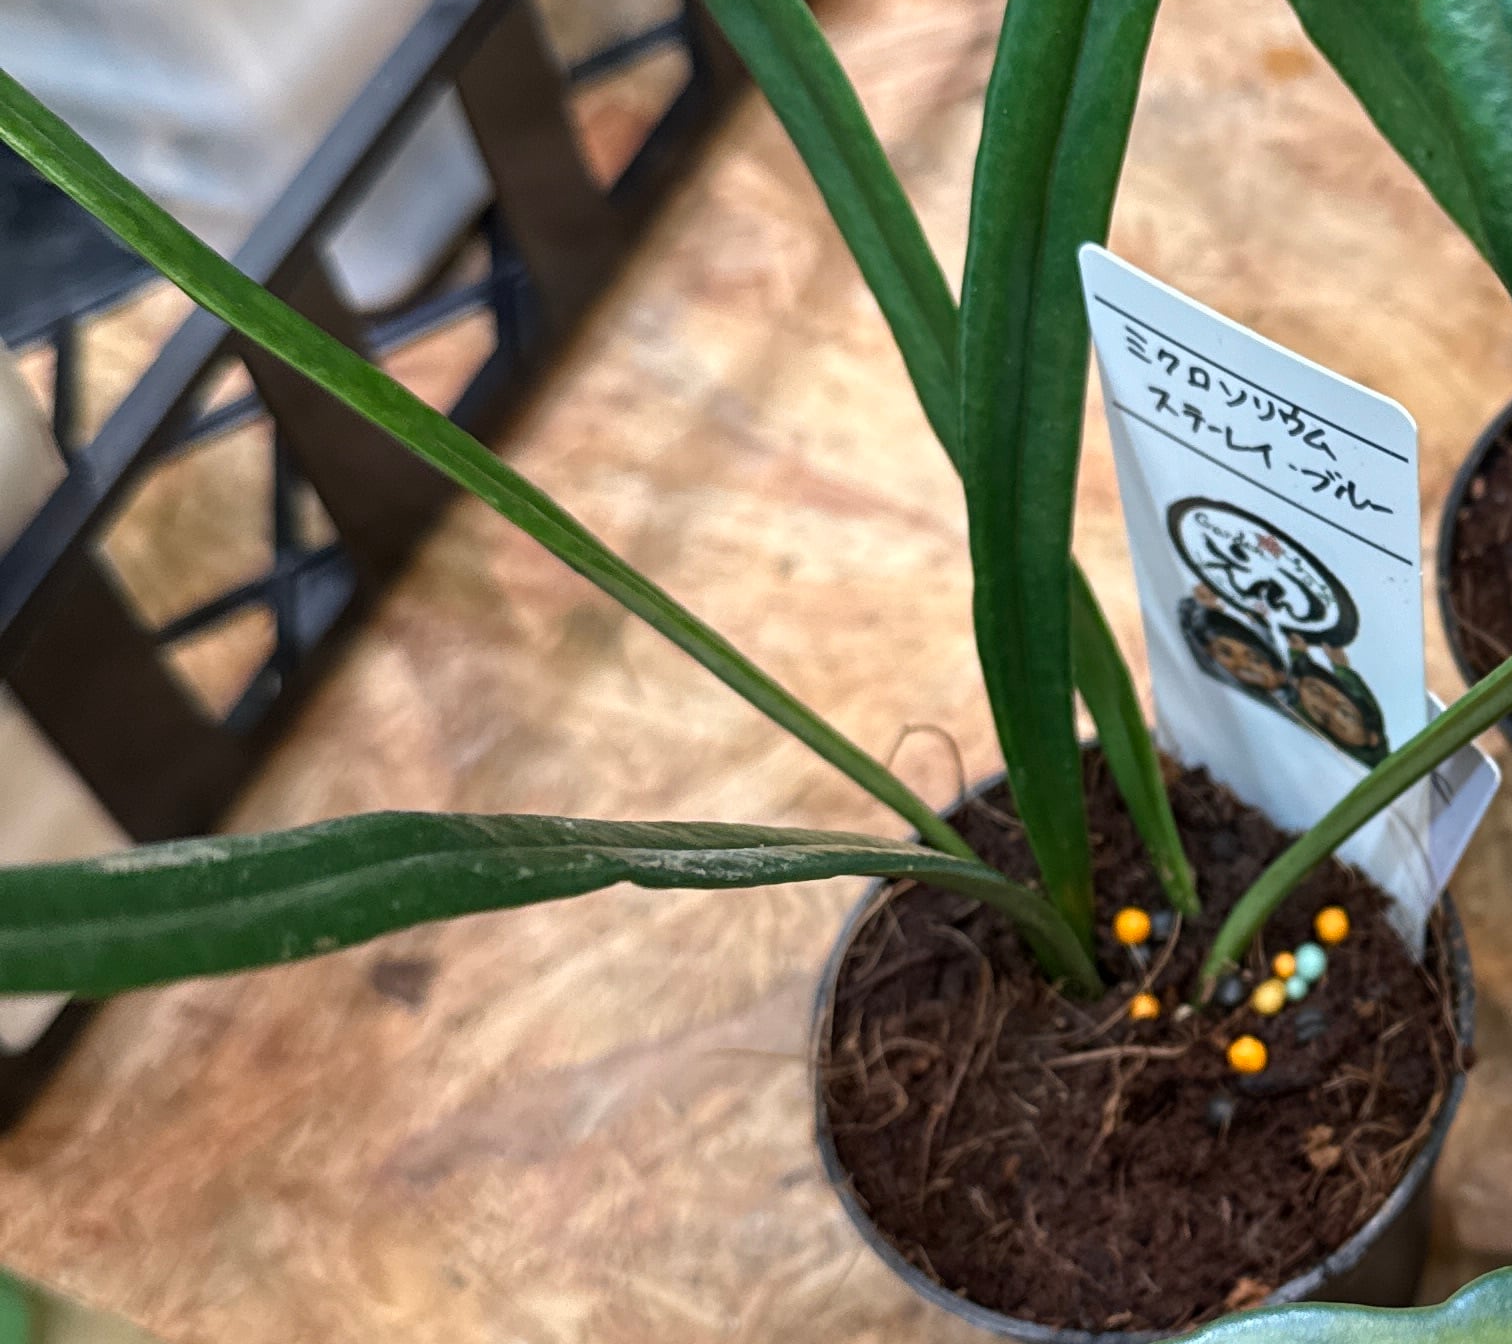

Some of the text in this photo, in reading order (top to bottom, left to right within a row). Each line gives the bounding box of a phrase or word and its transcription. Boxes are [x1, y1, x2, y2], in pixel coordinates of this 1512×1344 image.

[1124, 324, 1338, 462] ミクロソリウム
